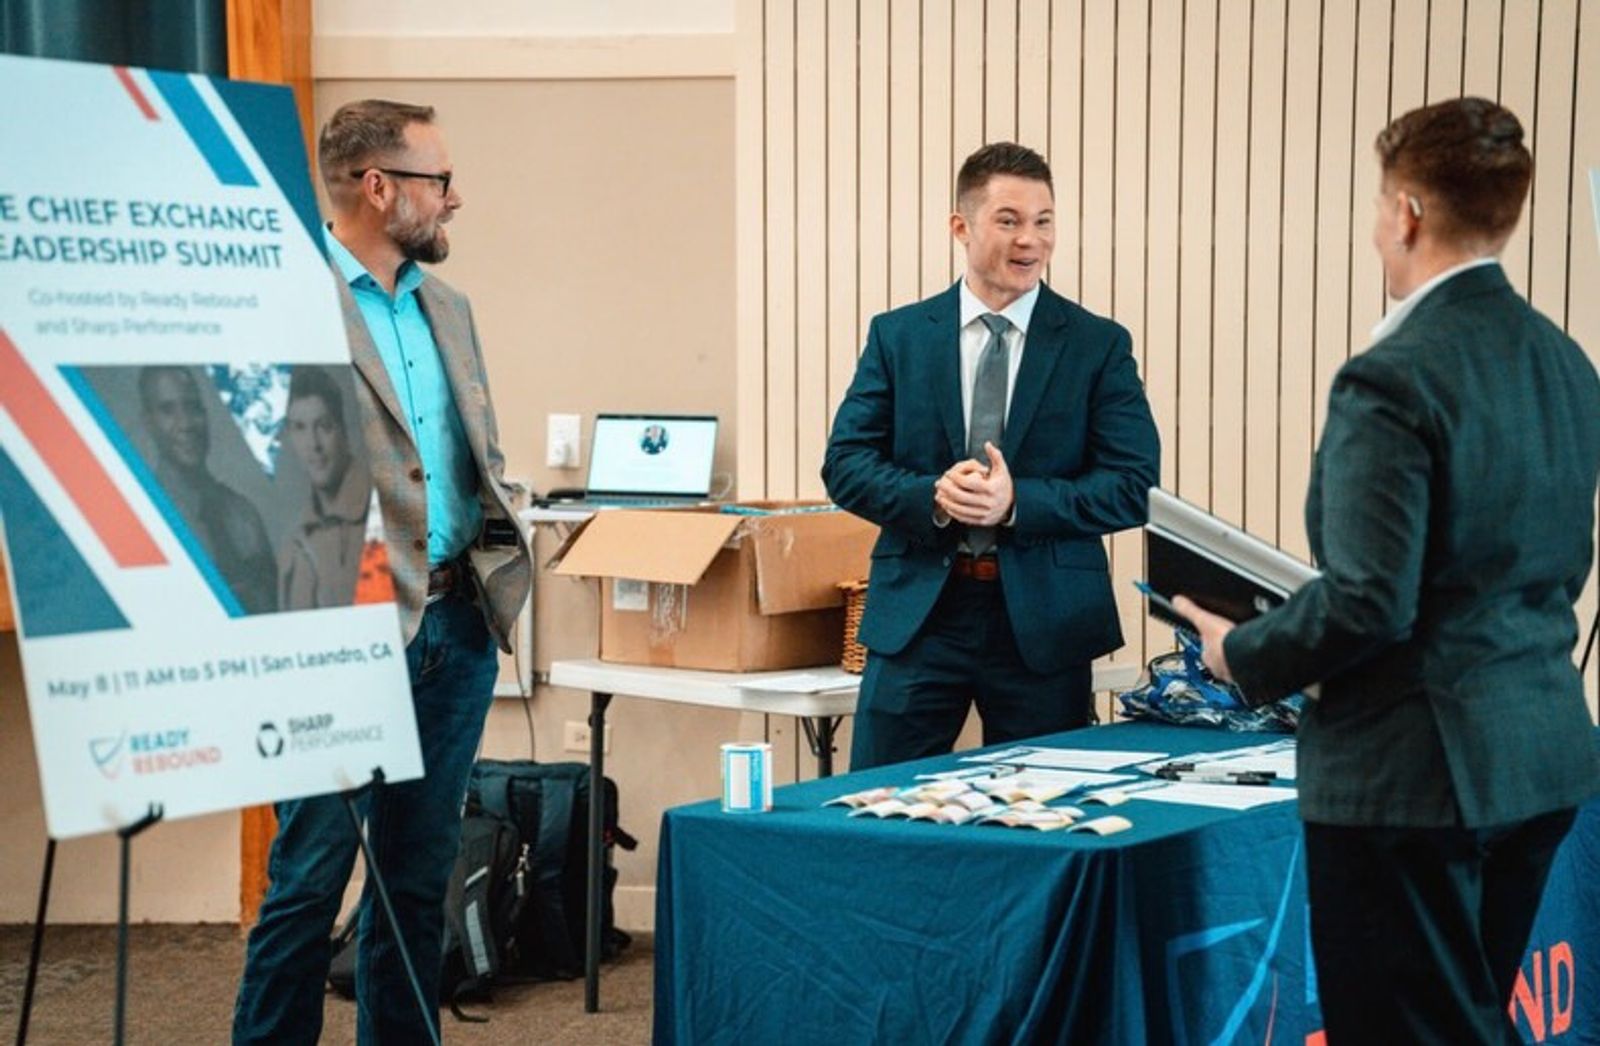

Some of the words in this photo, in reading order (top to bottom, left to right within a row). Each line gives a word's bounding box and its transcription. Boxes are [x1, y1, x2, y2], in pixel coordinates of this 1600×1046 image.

[28, 196, 118, 225] CHIEF
[129, 201, 282, 233] EXCHANGE
[177, 240, 282, 268] SUMMIT
[28, 290, 114, 308] Co-hosted
[117, 291, 137, 310] by
[141, 291, 188, 311] Ready
[192, 293, 259, 309] Rebound
[36, 318, 68, 335] and
[71, 317, 118, 337] Sharp
[122, 318, 222, 336] Performance
[48, 680, 90, 699] May
[124, 670, 140, 689] 11
[145, 667, 175, 686] AM
[179, 665, 199, 682] to
[203, 661, 215, 680] 5
[218, 658, 247, 677] PM
[261, 654, 295, 673] San
[297, 646, 368, 669] Leandro,
[370, 643, 393, 661] CA
[287, 713, 335, 735] SHARP
[129, 728, 190, 753] READY
[132, 746, 222, 775] REBOUND
